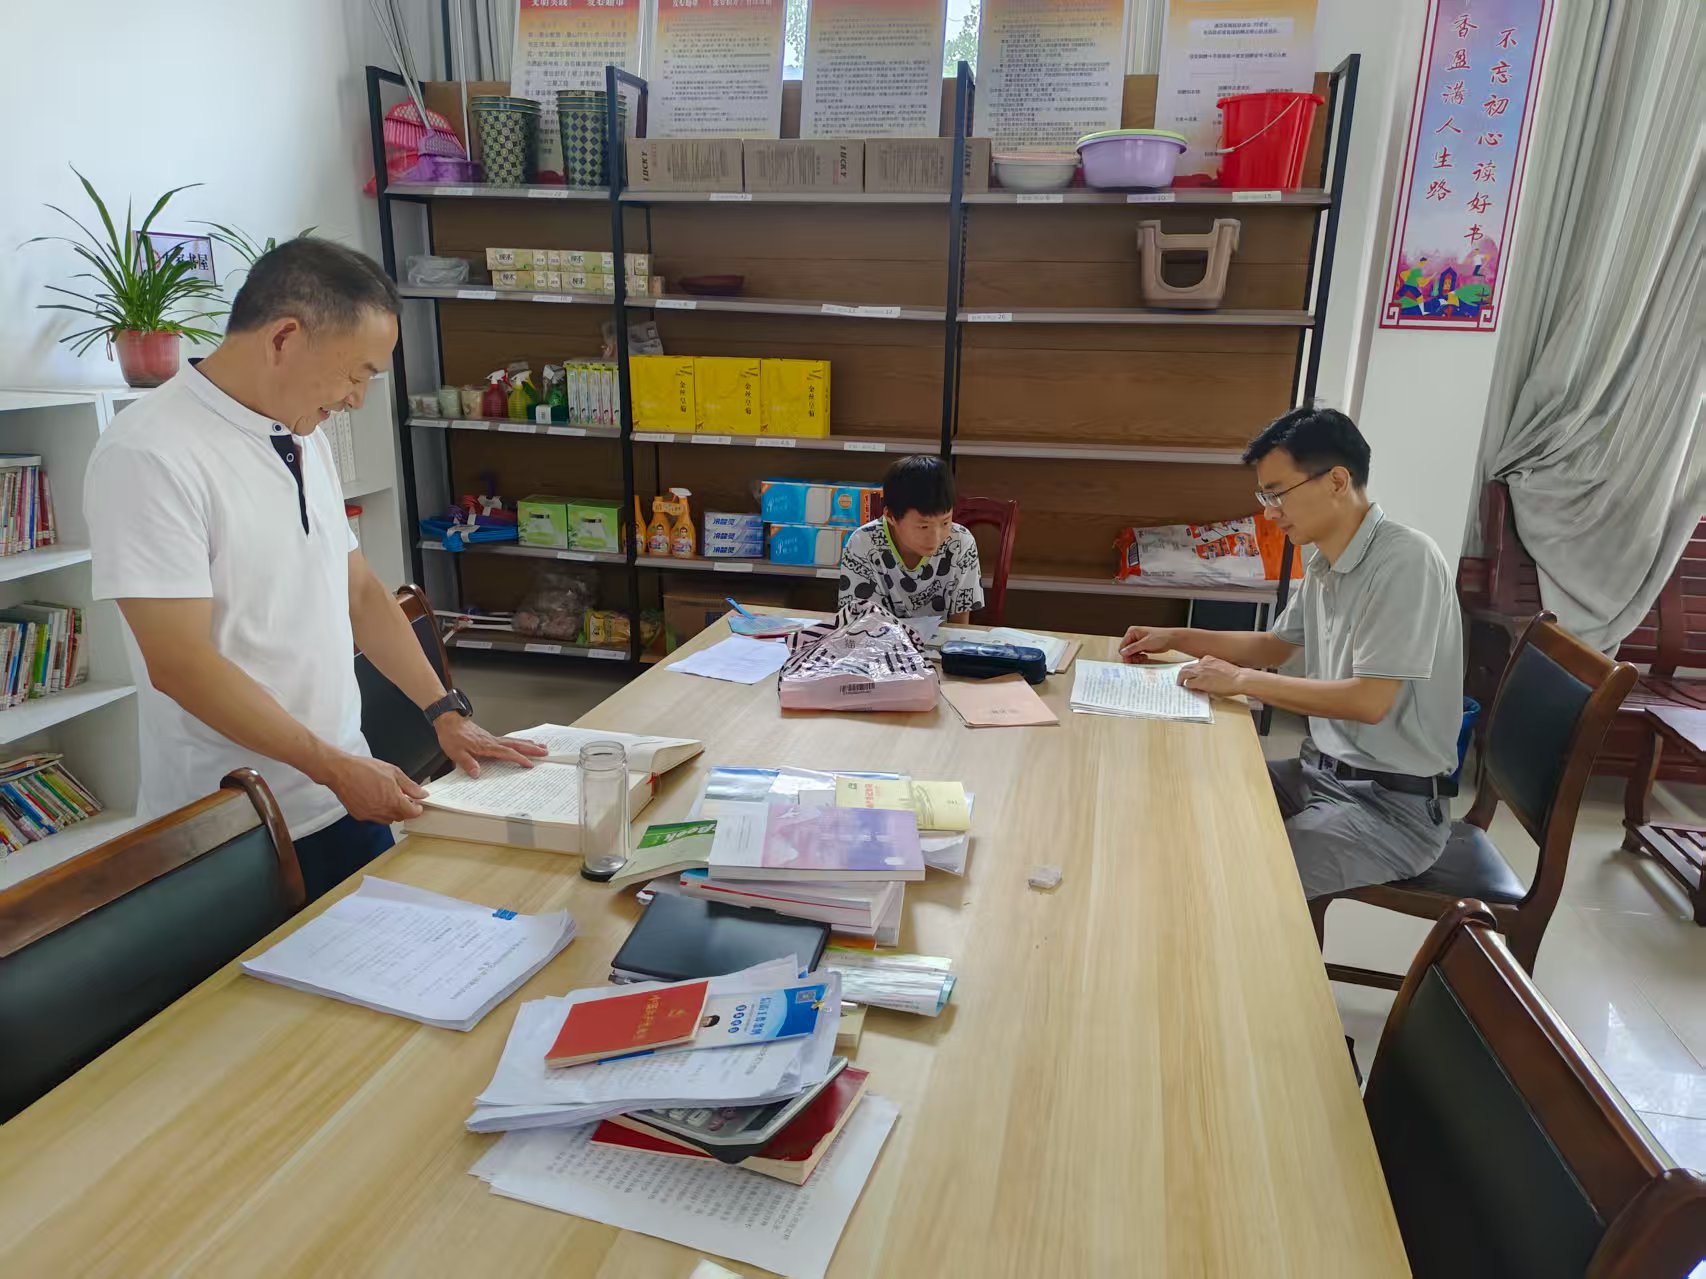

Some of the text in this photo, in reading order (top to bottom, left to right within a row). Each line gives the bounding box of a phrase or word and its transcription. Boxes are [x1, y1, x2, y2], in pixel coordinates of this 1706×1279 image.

[1426, 1, 1479, 201] 香盈满人生路
[1463, 27, 1518, 246] 不忘初心读好书
[713, 518, 736, 526] 冷酸灵
[713, 532, 736, 540] 冷酸灵
[713, 546, 736, 554] 冷酸灵
